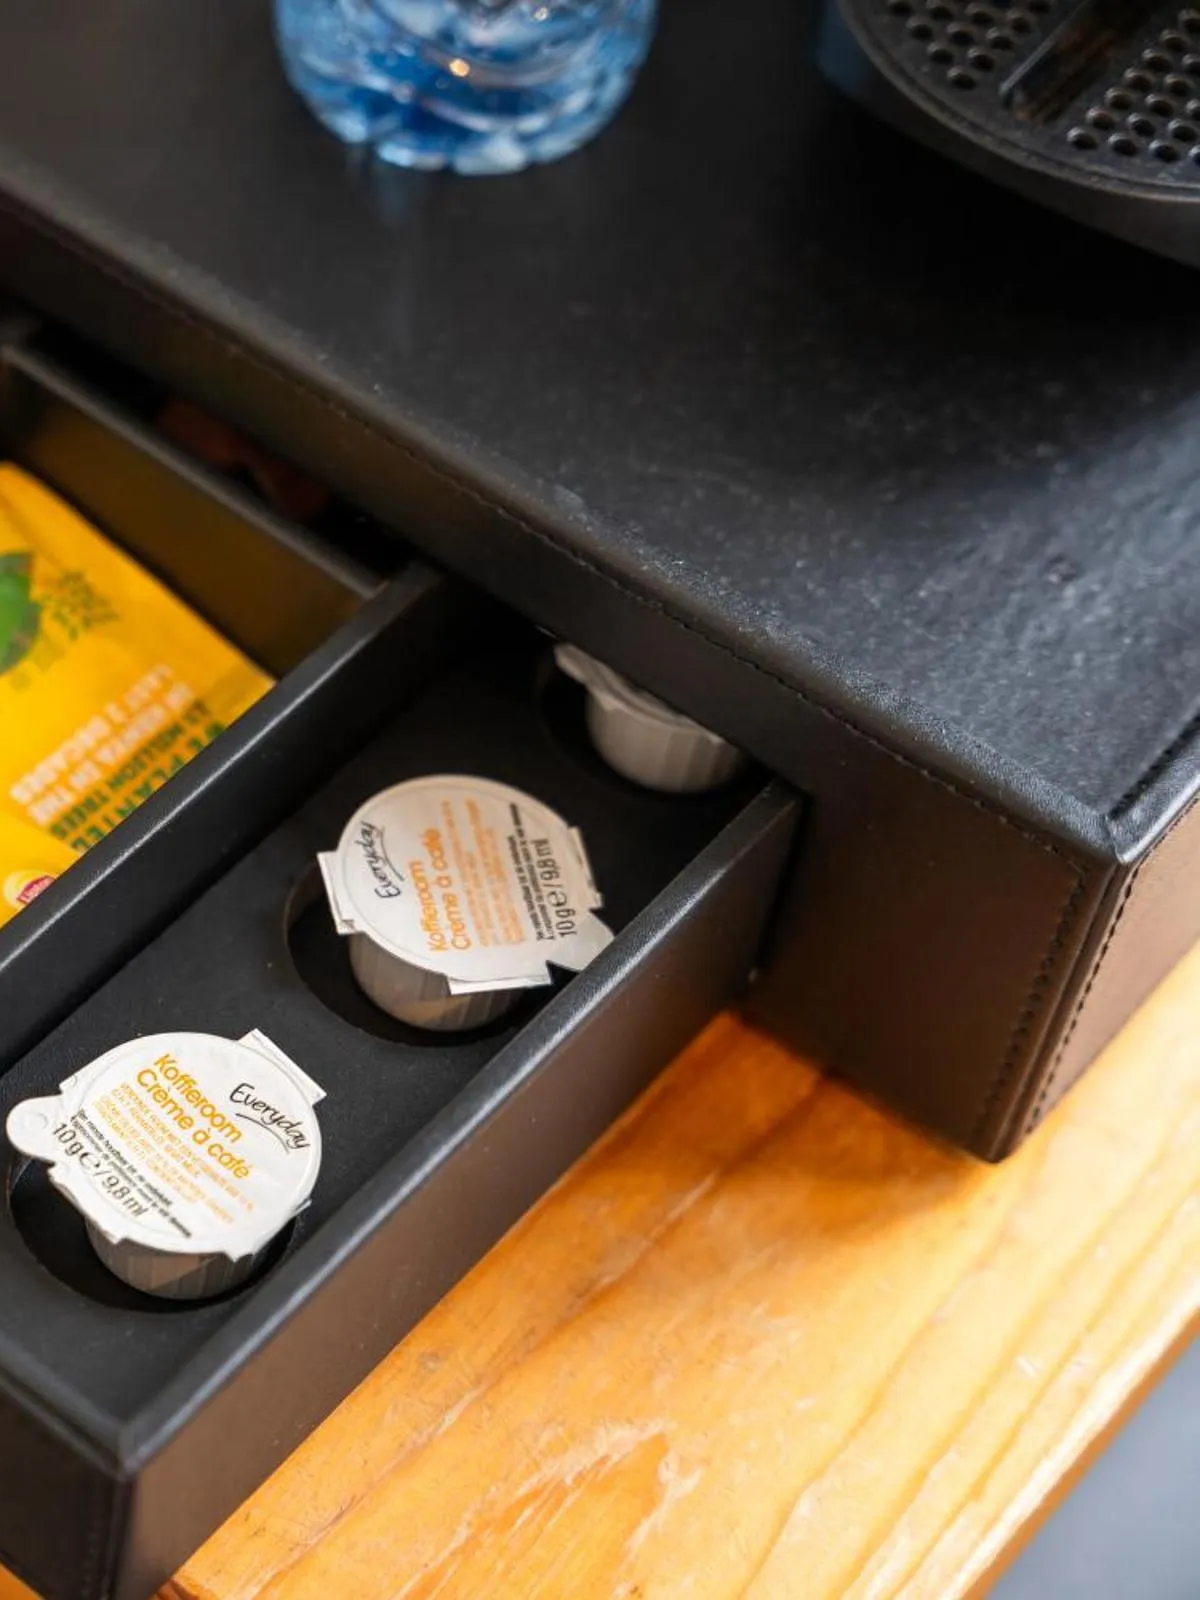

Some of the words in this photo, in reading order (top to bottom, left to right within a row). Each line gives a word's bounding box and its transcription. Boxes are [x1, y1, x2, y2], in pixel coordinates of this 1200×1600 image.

[354, 819, 403, 899] Everyday
[136, 1068, 195, 1130] Crème
[191, 1126, 211, 1145] à
[207, 1143, 254, 1179] café
[153, 1053, 243, 1144] Koffieroom
[229, 1082, 311, 1151] Everyday
